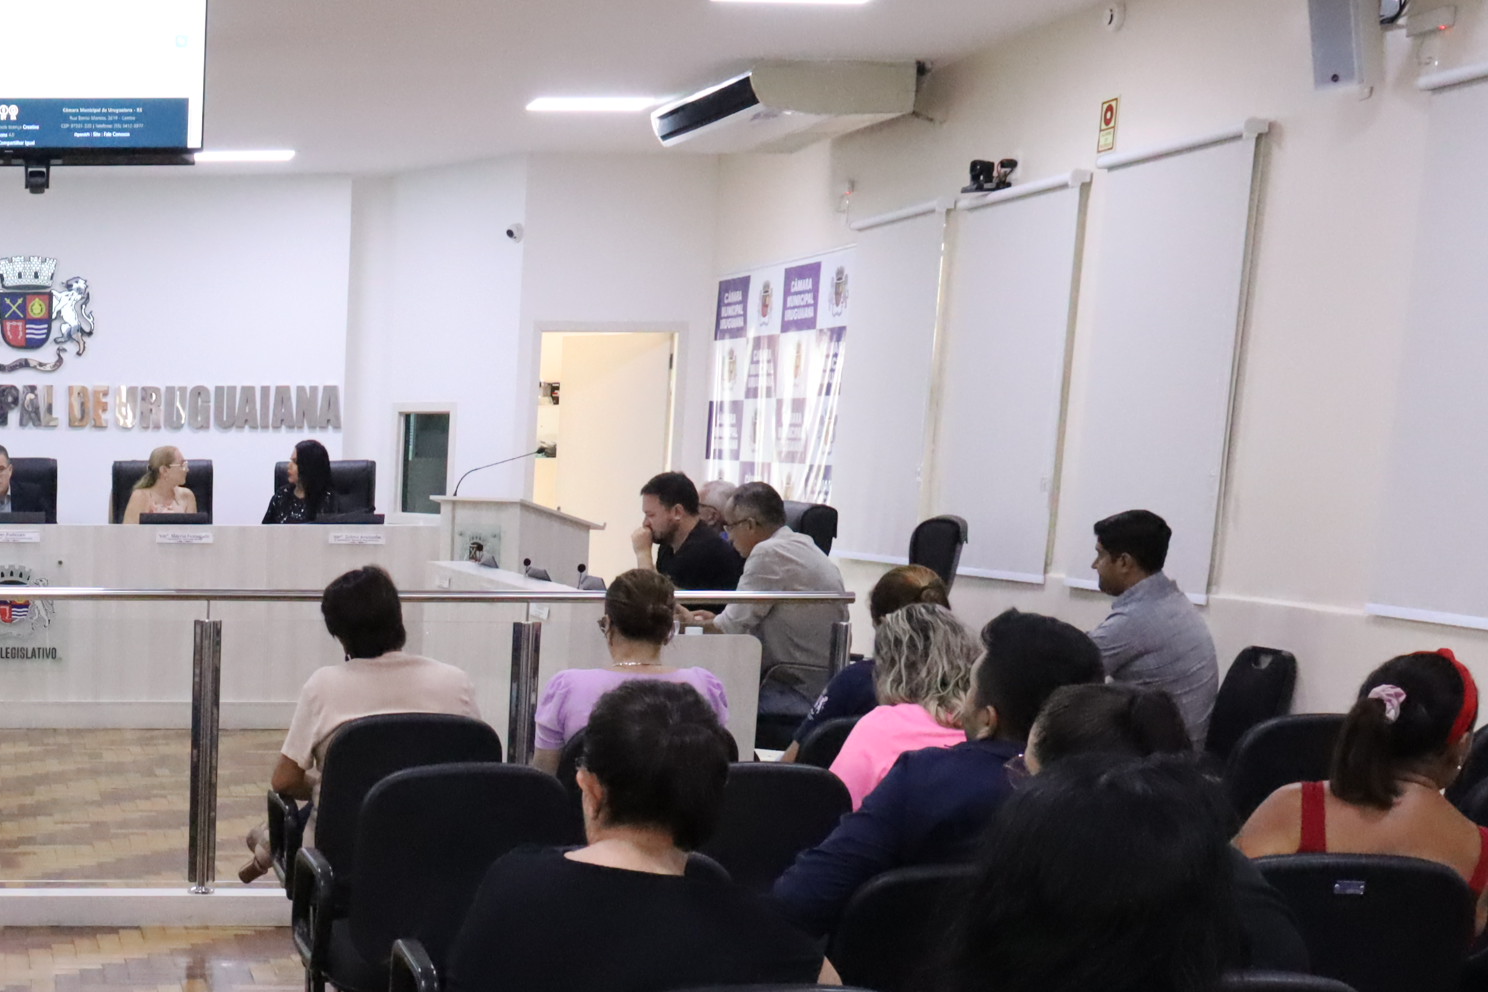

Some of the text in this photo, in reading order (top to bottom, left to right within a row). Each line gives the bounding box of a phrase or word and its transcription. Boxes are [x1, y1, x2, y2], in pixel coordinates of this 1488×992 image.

[68, 384, 109, 428] DE
[115, 384, 342, 429] URUGUAIANA
[0, 646, 57, 660] LEGISLATIVO
